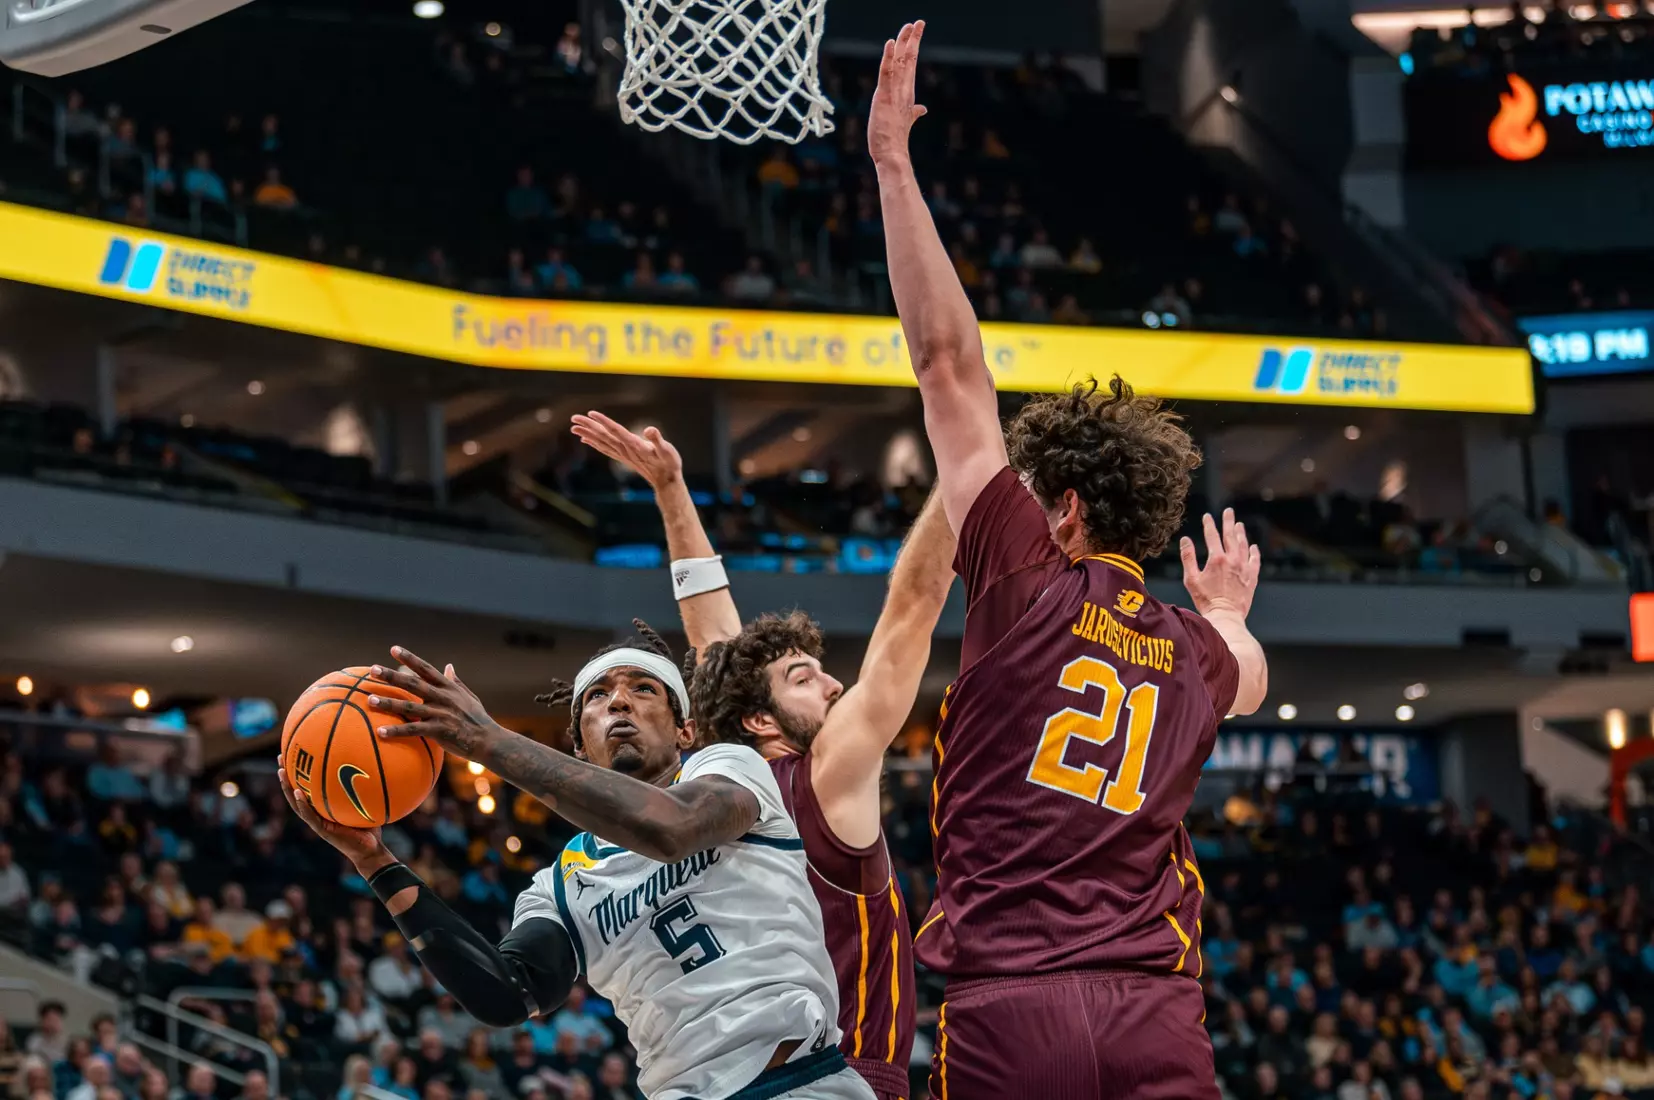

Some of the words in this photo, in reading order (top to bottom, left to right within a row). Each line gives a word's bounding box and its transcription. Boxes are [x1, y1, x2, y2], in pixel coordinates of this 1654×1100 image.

[452, 303, 609, 366] Fueling
[623, 320, 694, 358] the
[709, 320, 850, 366] Future
[862, 331, 902, 367] of
[1594, 327, 1649, 361] PM
[1072, 601, 1175, 675] JARUSEVICIUS
[1026, 655, 1160, 816] 21
[649, 894, 727, 976] 5
